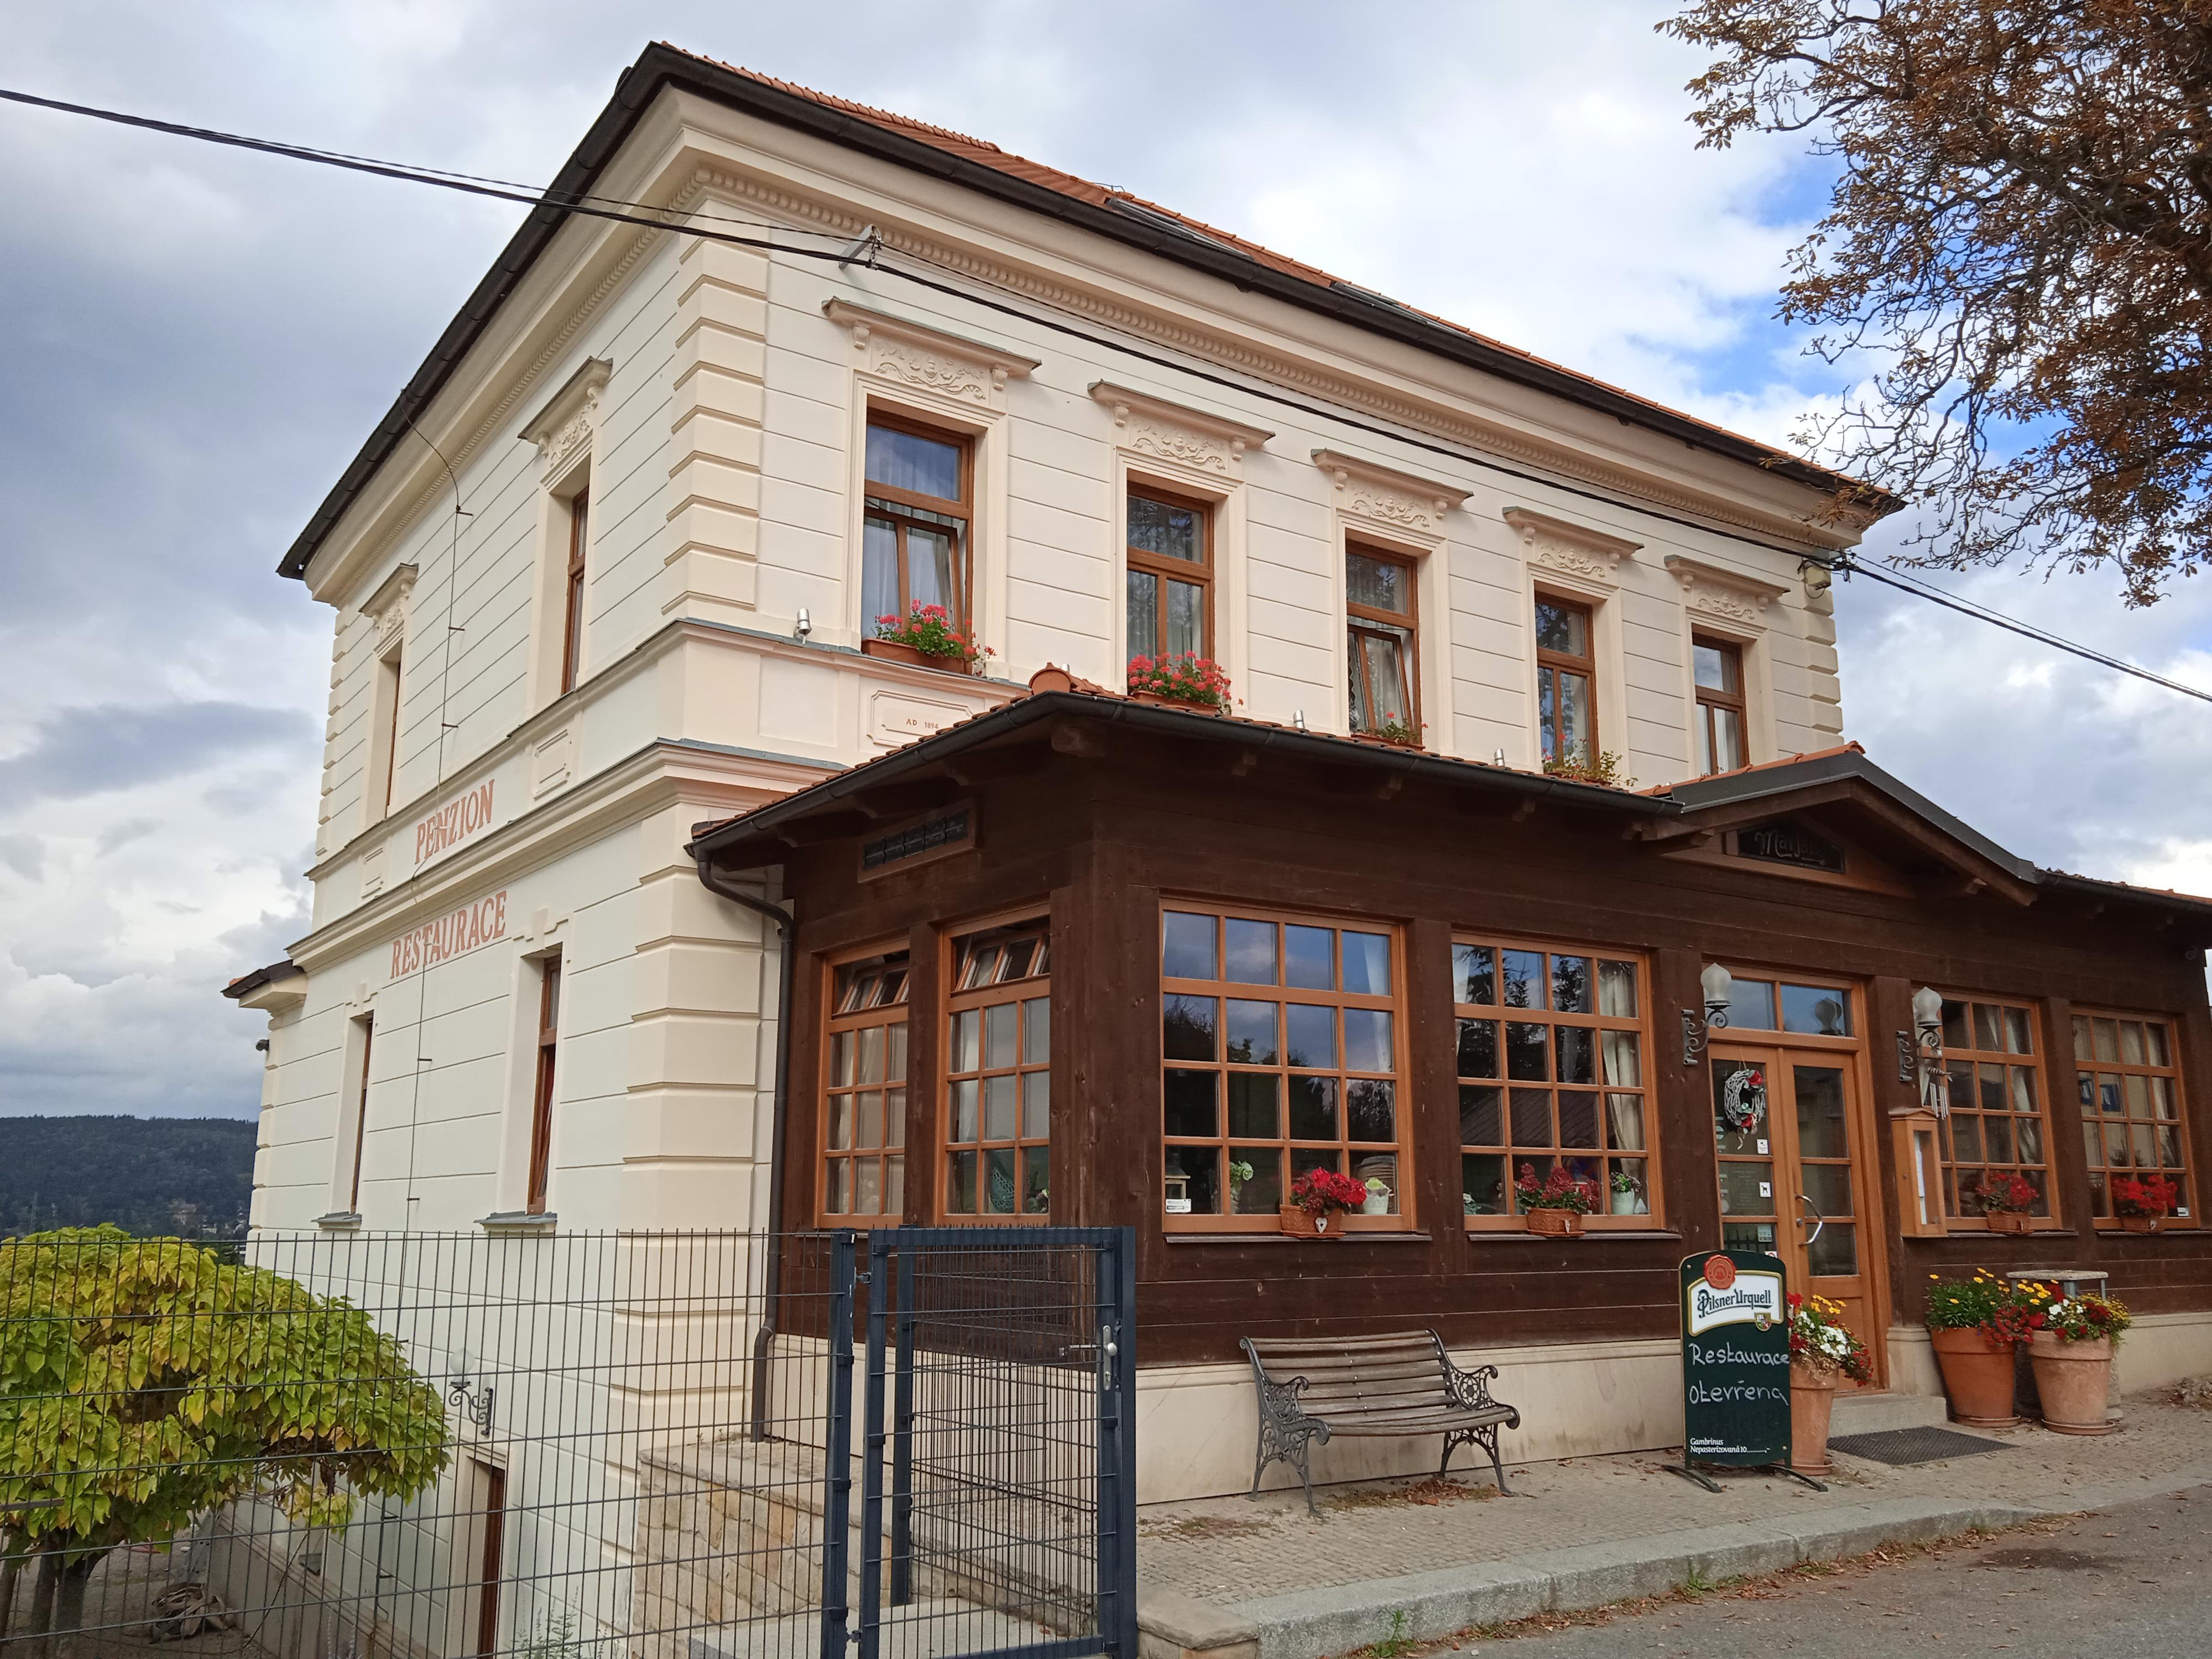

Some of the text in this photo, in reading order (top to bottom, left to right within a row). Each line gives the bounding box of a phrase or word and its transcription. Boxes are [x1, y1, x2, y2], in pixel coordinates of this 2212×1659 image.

[415, 779, 494, 865] PENZION
[390, 890, 507, 979] RESTAURACE
[1697, 1288, 1771, 1318] Pilsner Urquell
[1688, 1341, 1790, 1366] Restaurace
[1690, 1437, 1724, 1446] Gambrinus
[1690, 1445, 1739, 1454] Nepasterizovaná
